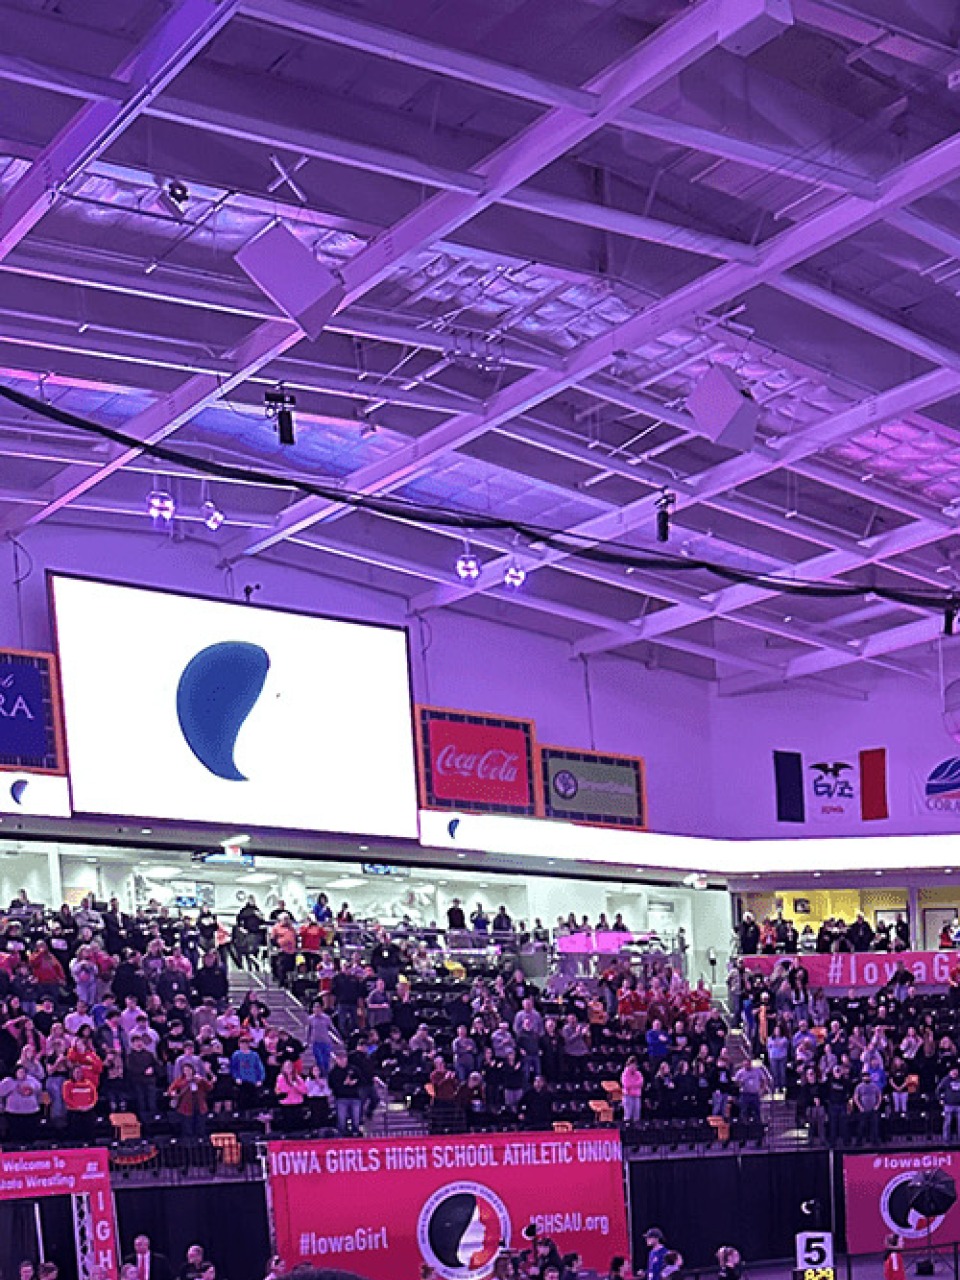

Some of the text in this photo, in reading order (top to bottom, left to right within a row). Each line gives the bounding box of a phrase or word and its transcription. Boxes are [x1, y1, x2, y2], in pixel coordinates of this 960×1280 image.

[3, 1157, 51, 1172] Welcome
[271, 1139, 623, 1176] IOWA GIRLS HIGH SCHOOL ATHLETIC UNION
[872, 1155, 953, 1169] #IowaGirl
[25, 1173, 76, 1189] Wrestling
[299, 1226, 389, 1255] #IowaGirl
[804, 1237, 827, 1265] 5
